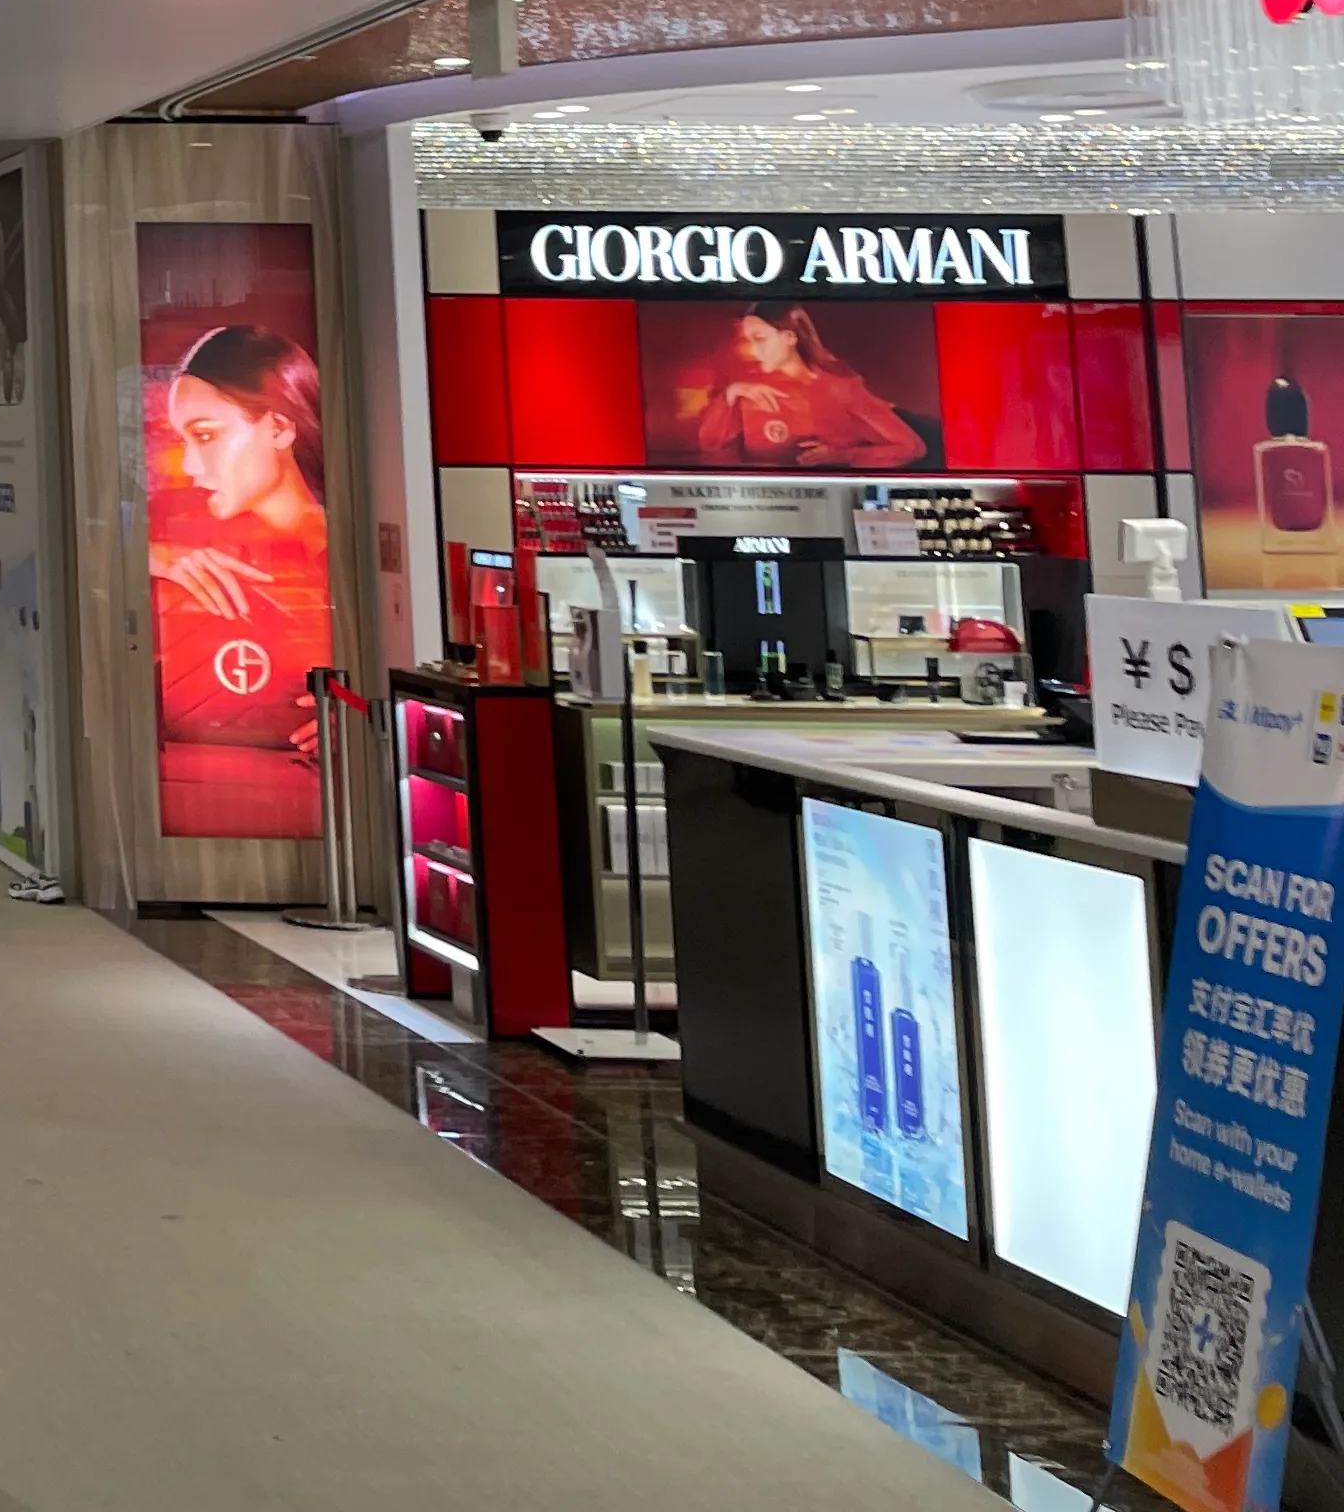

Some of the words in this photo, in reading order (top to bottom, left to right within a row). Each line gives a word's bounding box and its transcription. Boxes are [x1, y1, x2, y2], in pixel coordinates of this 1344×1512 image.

[530, 224, 783, 284] GIORGIO
[800, 226, 1034, 285] ARMANI
[1112, 703, 1170, 735] Please
[1205, 854, 1285, 909] SCAN
[1285, 873, 1336, 923] FOR
[1198, 905, 1328, 986] OFFERS
[1175, 1098, 1213, 1138] Scan
[1215, 1120, 1253, 1156] with
